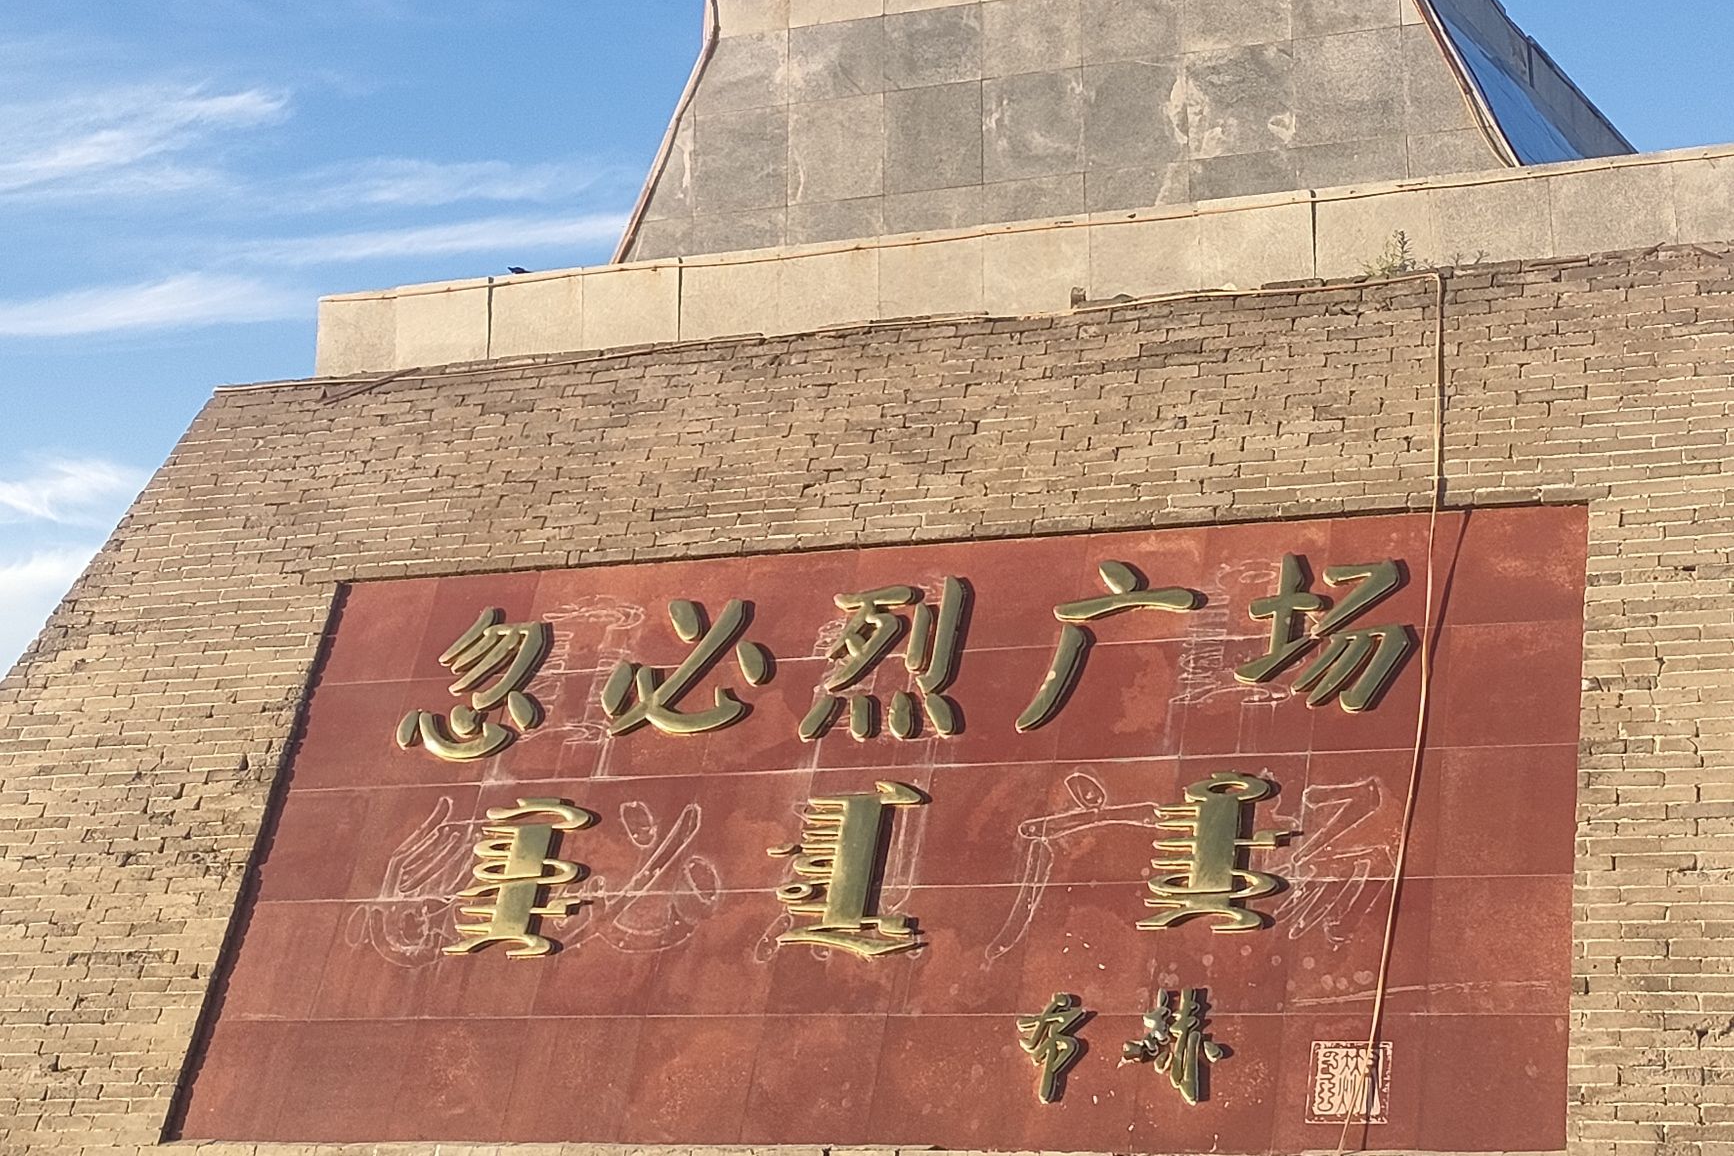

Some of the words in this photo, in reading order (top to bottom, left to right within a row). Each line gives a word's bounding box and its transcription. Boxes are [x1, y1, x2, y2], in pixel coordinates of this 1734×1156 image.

[396, 552, 1412, 762] 忽必烈广场
